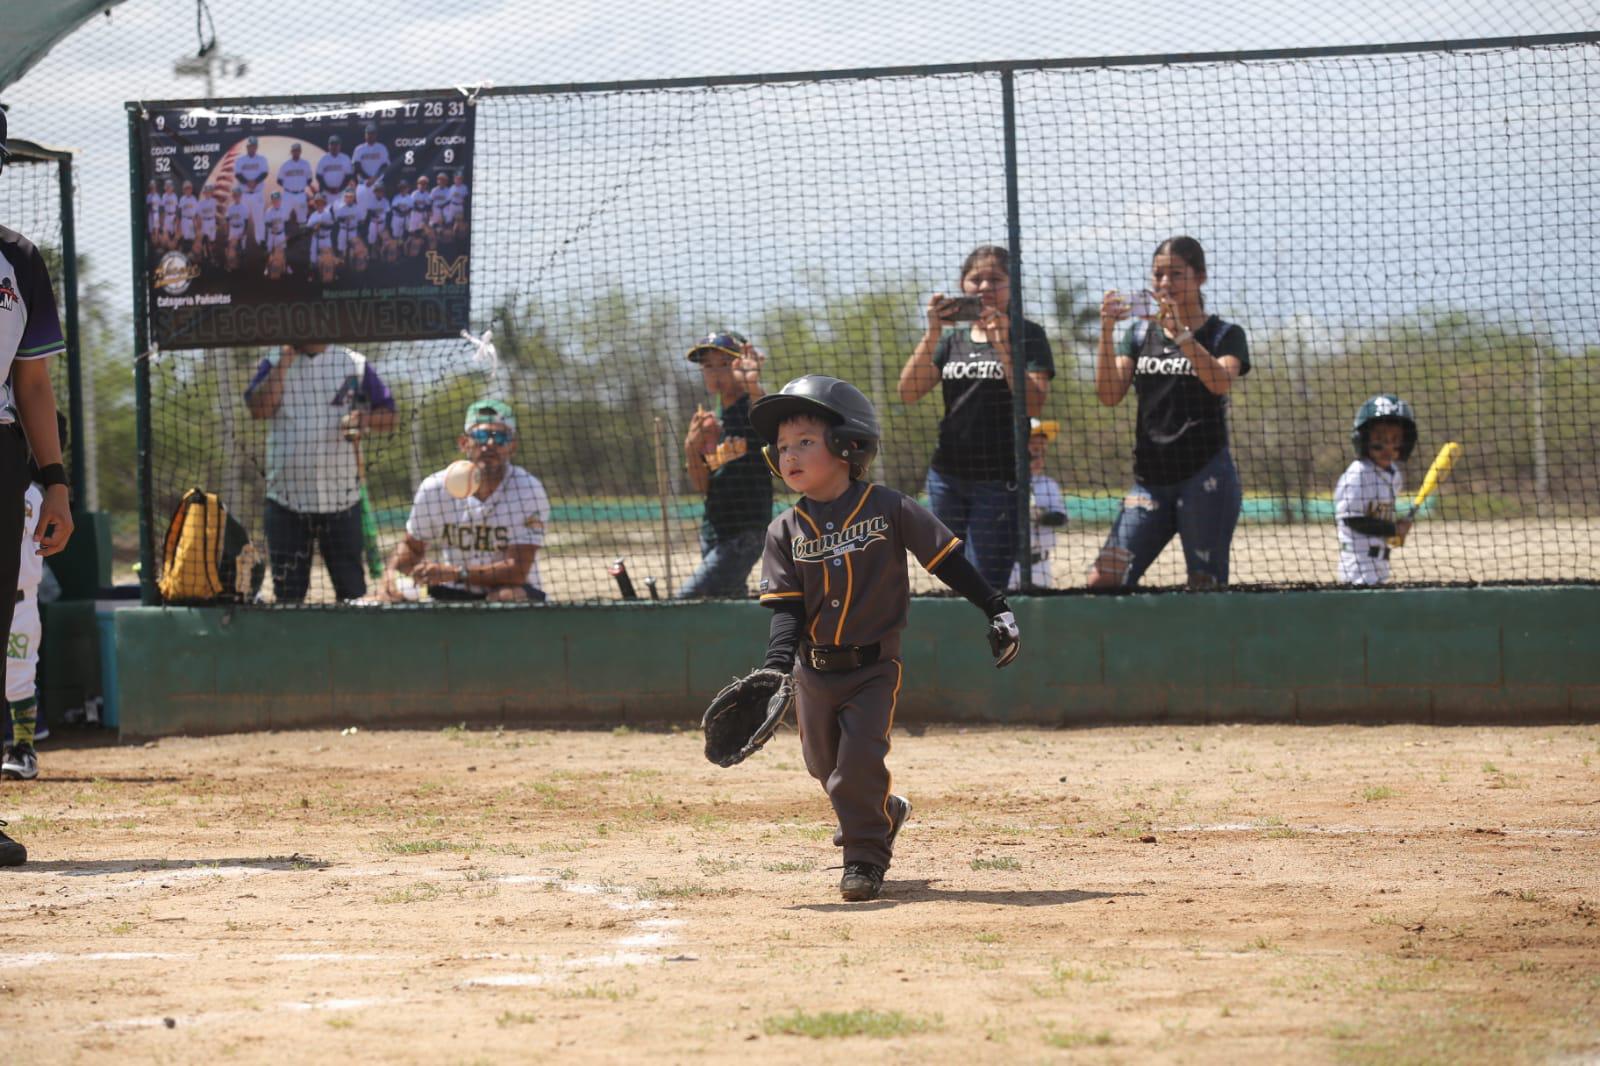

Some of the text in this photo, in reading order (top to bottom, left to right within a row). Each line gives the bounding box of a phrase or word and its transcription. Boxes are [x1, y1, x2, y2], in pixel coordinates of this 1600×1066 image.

[155, 115, 165, 131] 9
[179, 114, 198, 129] 30
[404, 103, 419, 118] 17
[424, 102, 444, 117] 26
[448, 101, 465, 117] 31
[434, 135, 466, 146] COUCH
[155, 149, 454, 173] 52 28 8 9
[153, 297, 468, 344] SELECCION VERDE
[942, 360, 1005, 380] MOCHIS
